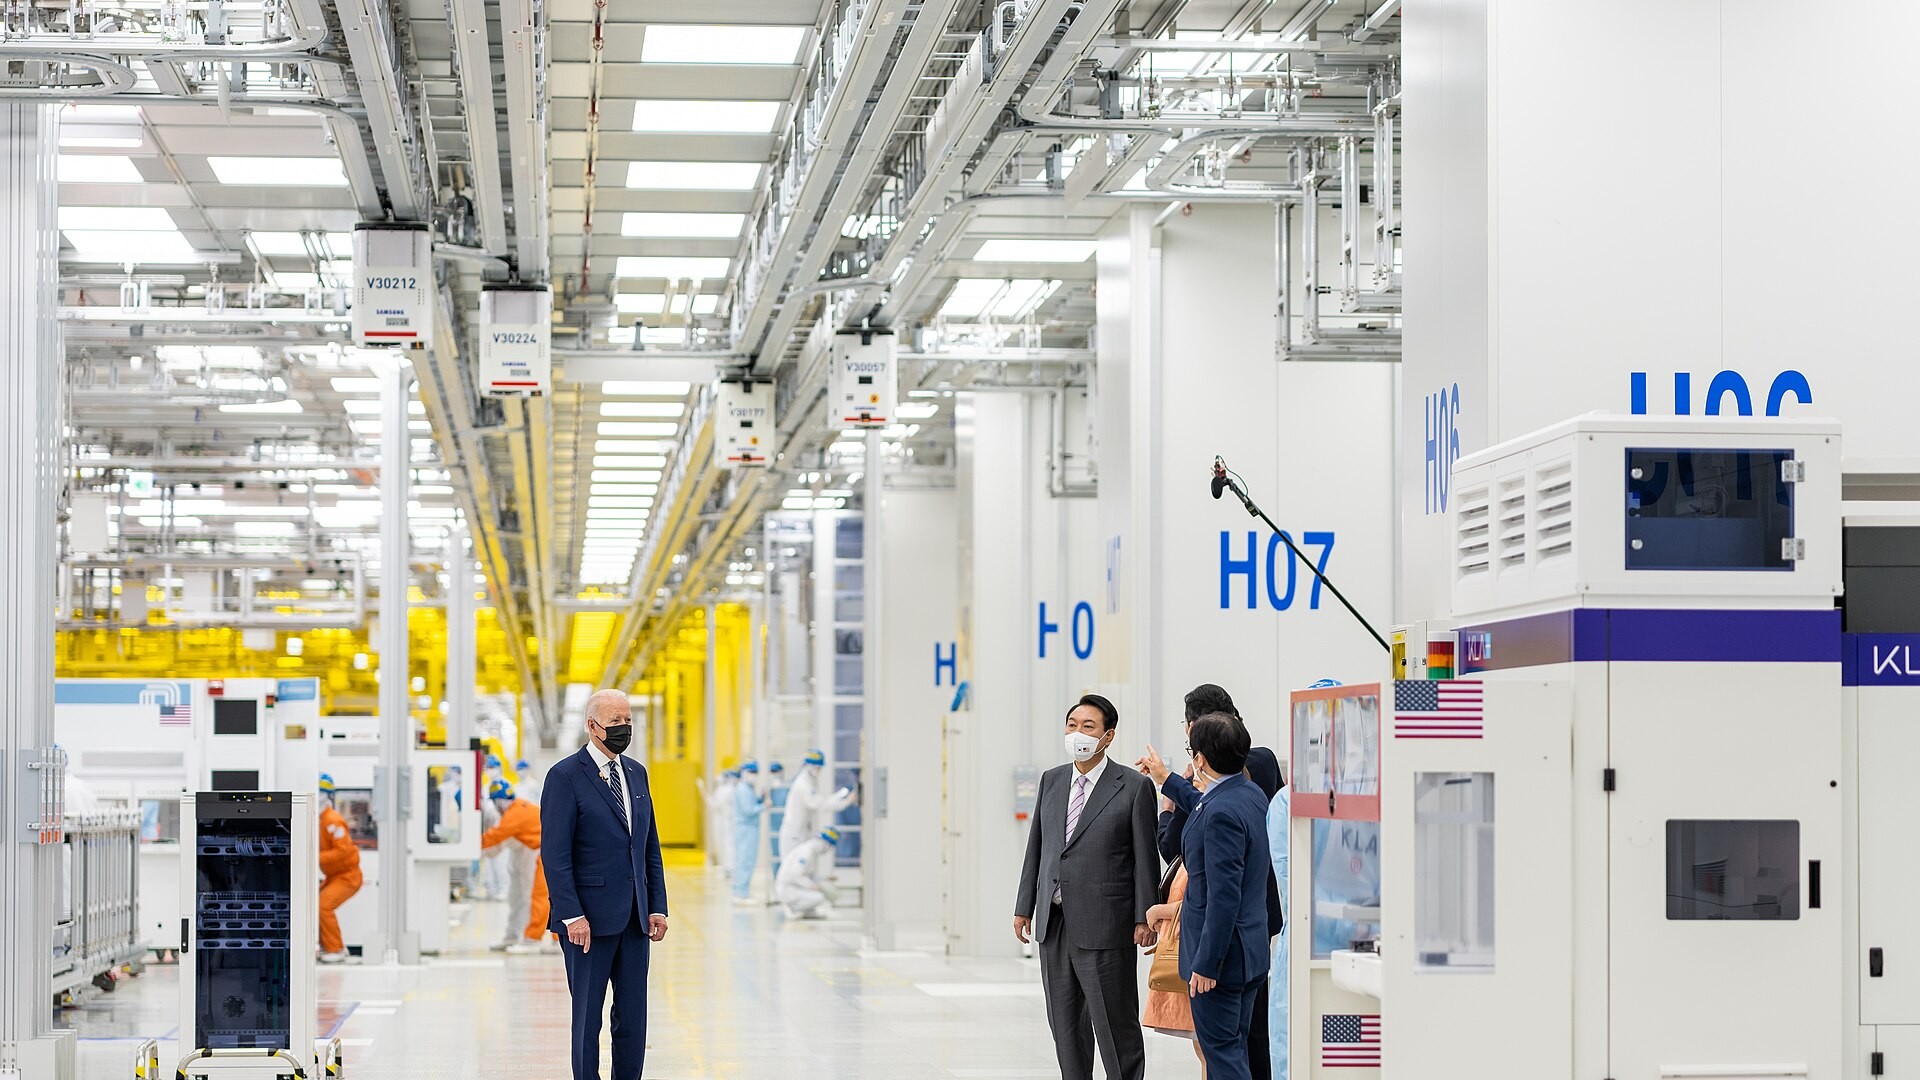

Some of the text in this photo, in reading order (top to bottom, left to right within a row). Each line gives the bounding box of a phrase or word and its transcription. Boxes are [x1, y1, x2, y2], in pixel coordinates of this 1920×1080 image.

[367, 277, 416, 289] V30212
[493, 332, 537, 343] V30224
[1220, 530, 1335, 611] H07
[1341, 825, 1378, 857] KLA
